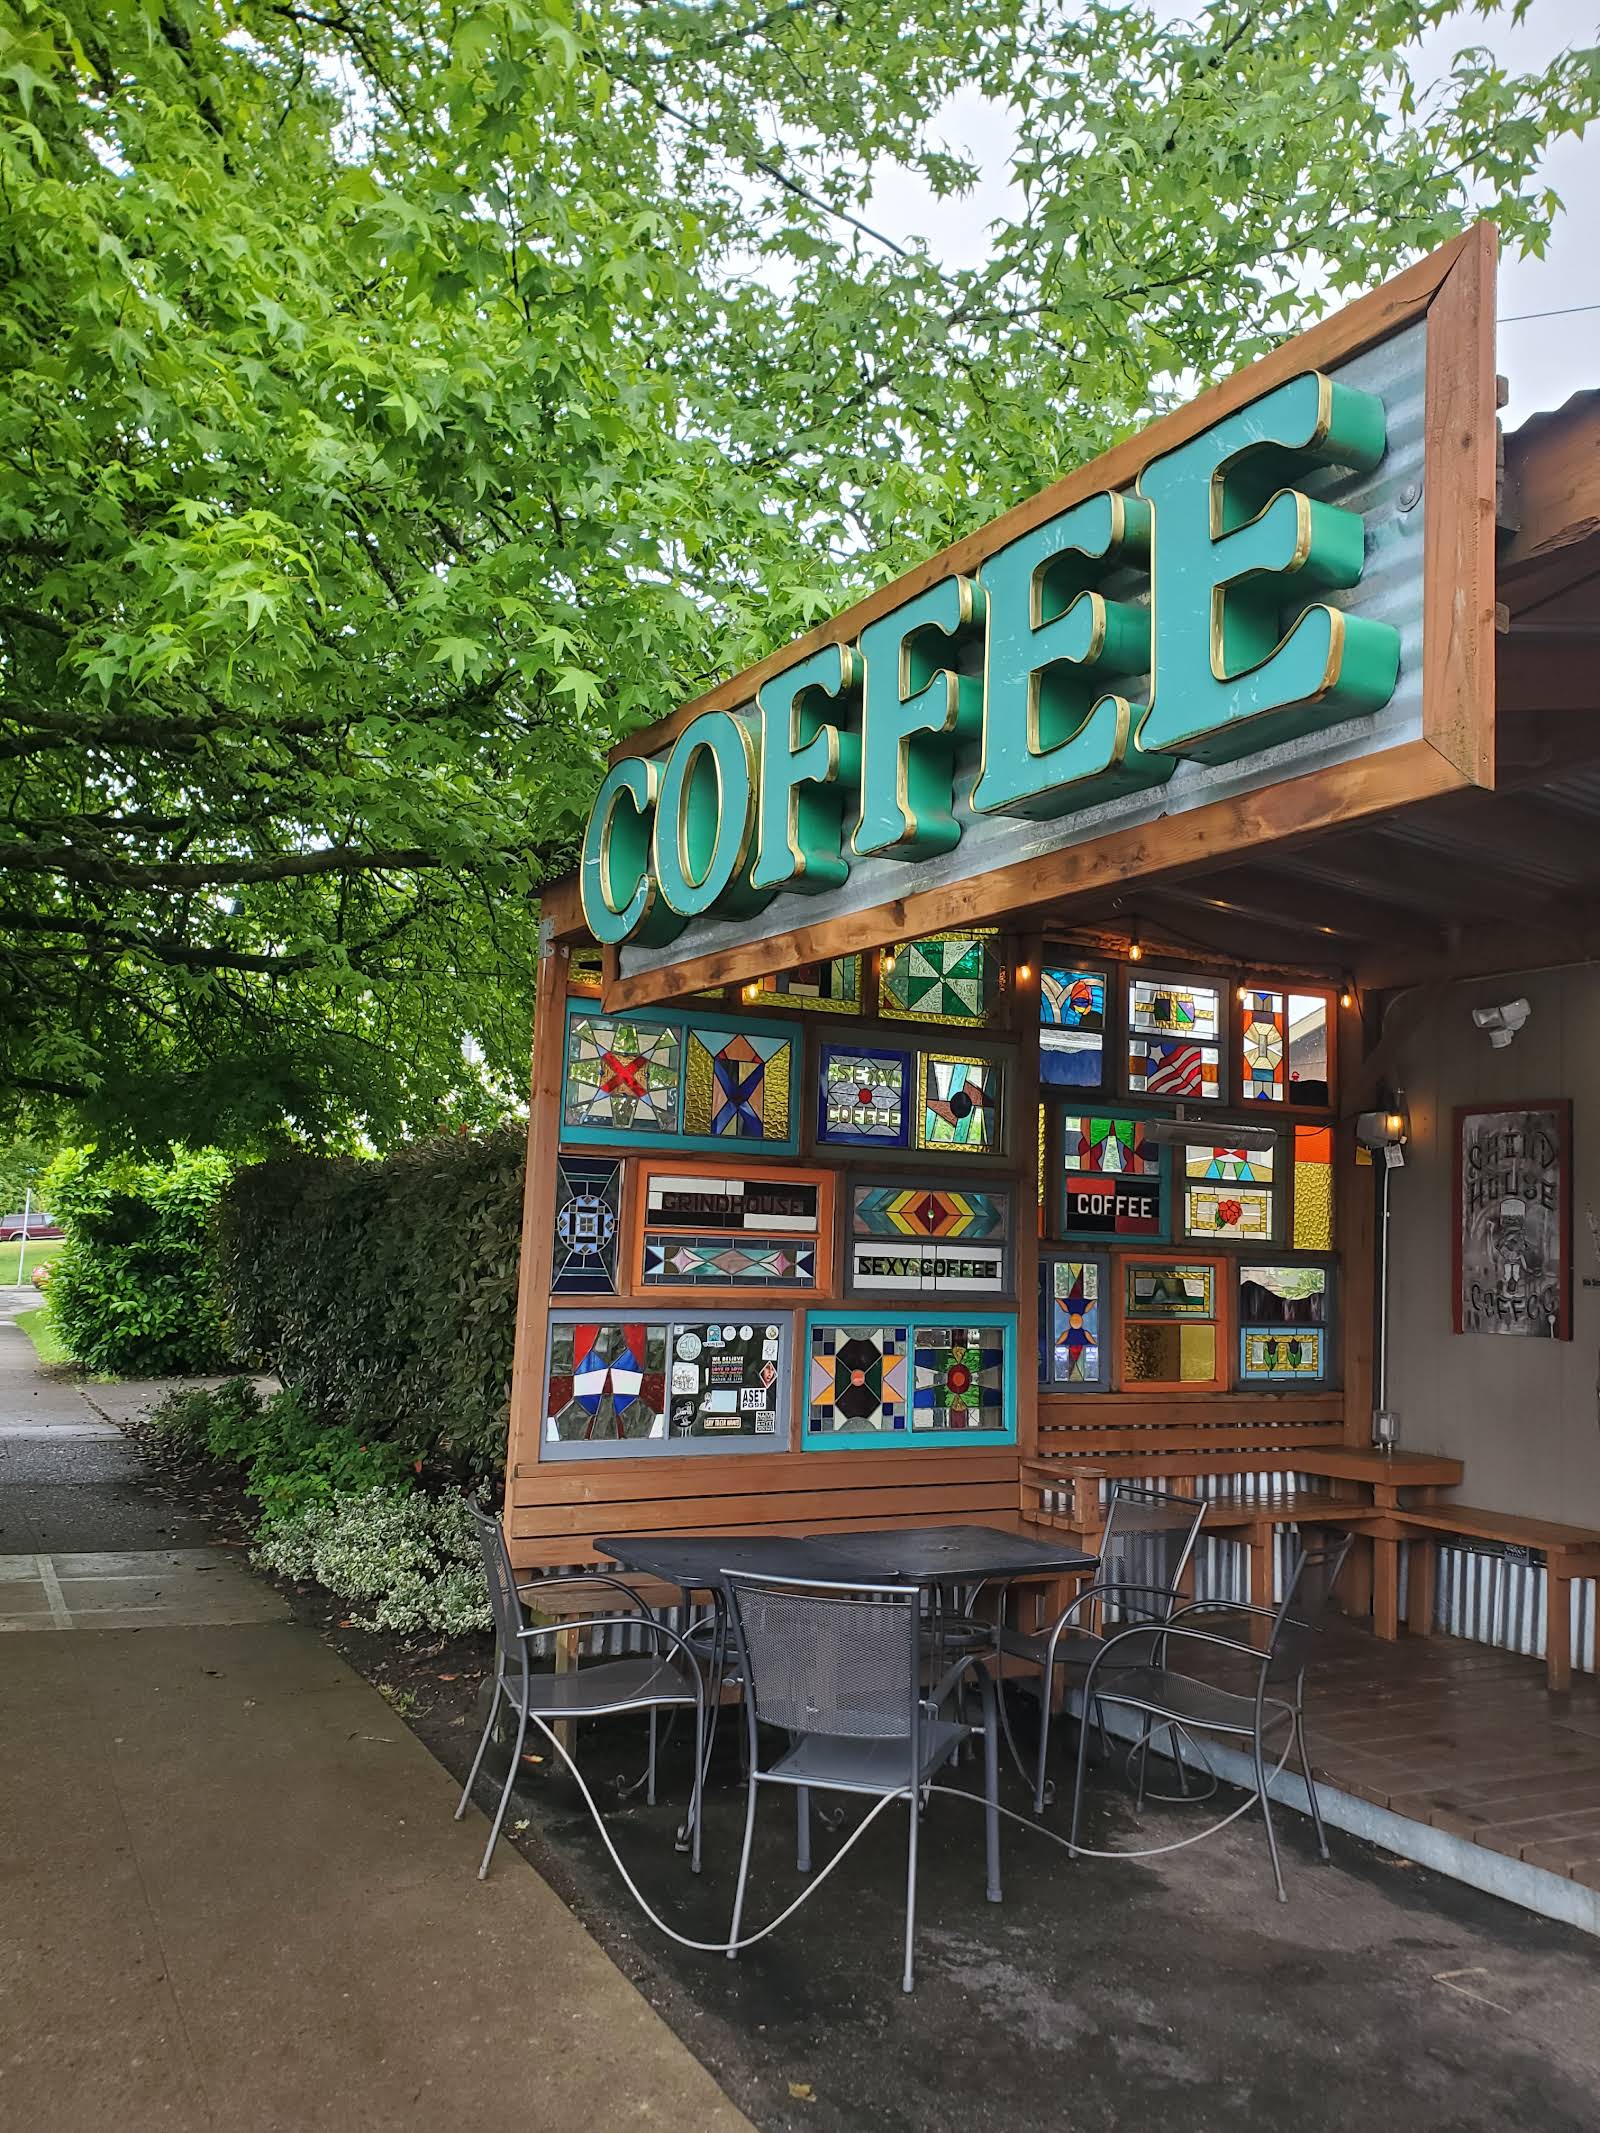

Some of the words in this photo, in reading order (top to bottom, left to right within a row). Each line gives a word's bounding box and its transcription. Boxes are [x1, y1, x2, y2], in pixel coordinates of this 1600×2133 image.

[581, 369, 1400, 949] COFFEE
[838, 1064, 894, 1087] SEXY
[827, 1104, 901, 1128] COFFEE
[664, 1191, 804, 1216] GRINDHOUSE
[1077, 1193, 1153, 1219] COFFEE
[859, 1256, 910, 1276] SEXY
[920, 1257, 997, 1279] COFFEE
[742, 1389, 765, 1402] ASET
